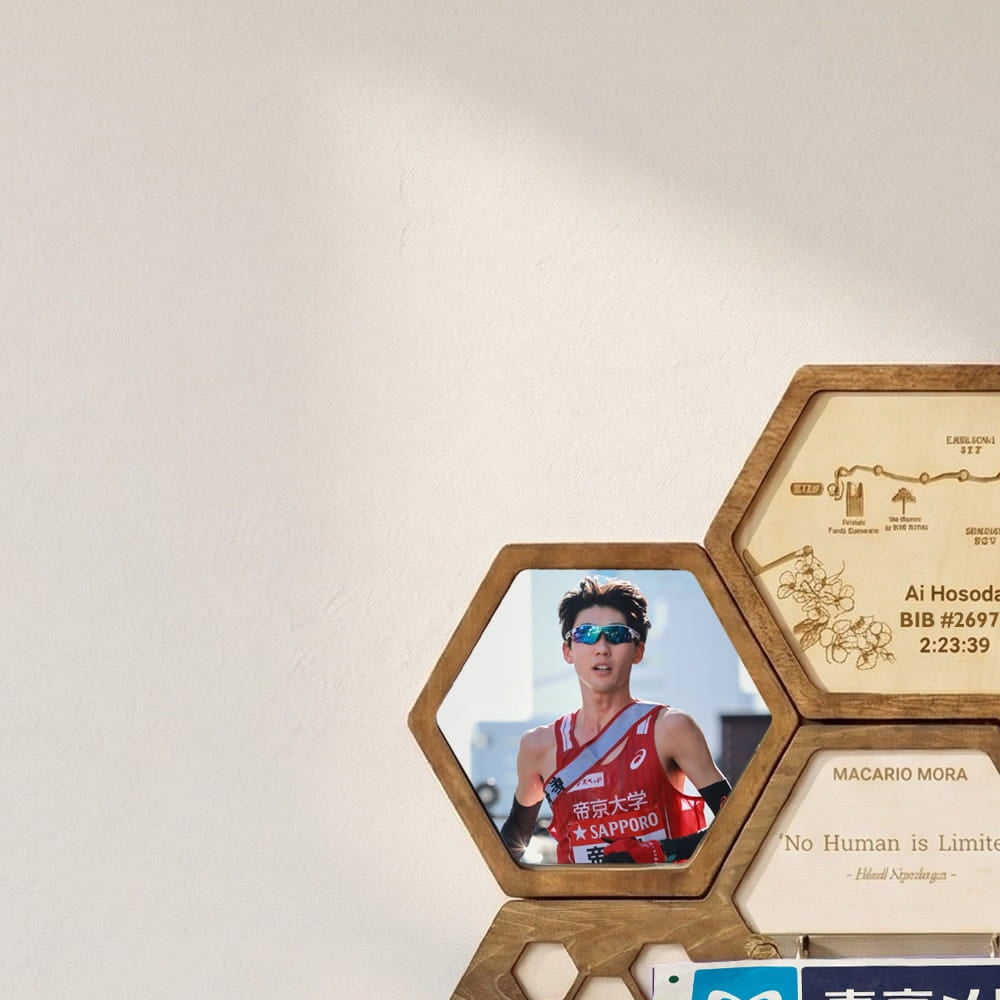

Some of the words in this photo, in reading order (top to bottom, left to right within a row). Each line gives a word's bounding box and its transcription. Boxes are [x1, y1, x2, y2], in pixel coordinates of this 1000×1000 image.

[904, 584, 924, 602] Ai
[899, 611, 935, 628] BIB
[919, 637, 990, 654] 2:23:39
[832, 767, 912, 782] MACARIO
[917, 767, 968, 782] MORA
[572, 789, 648, 821] 帝京大学
[590, 812, 659, 840] SAPPORO
[824, 834, 900, 852] Human
[911, 834, 929, 852] is
